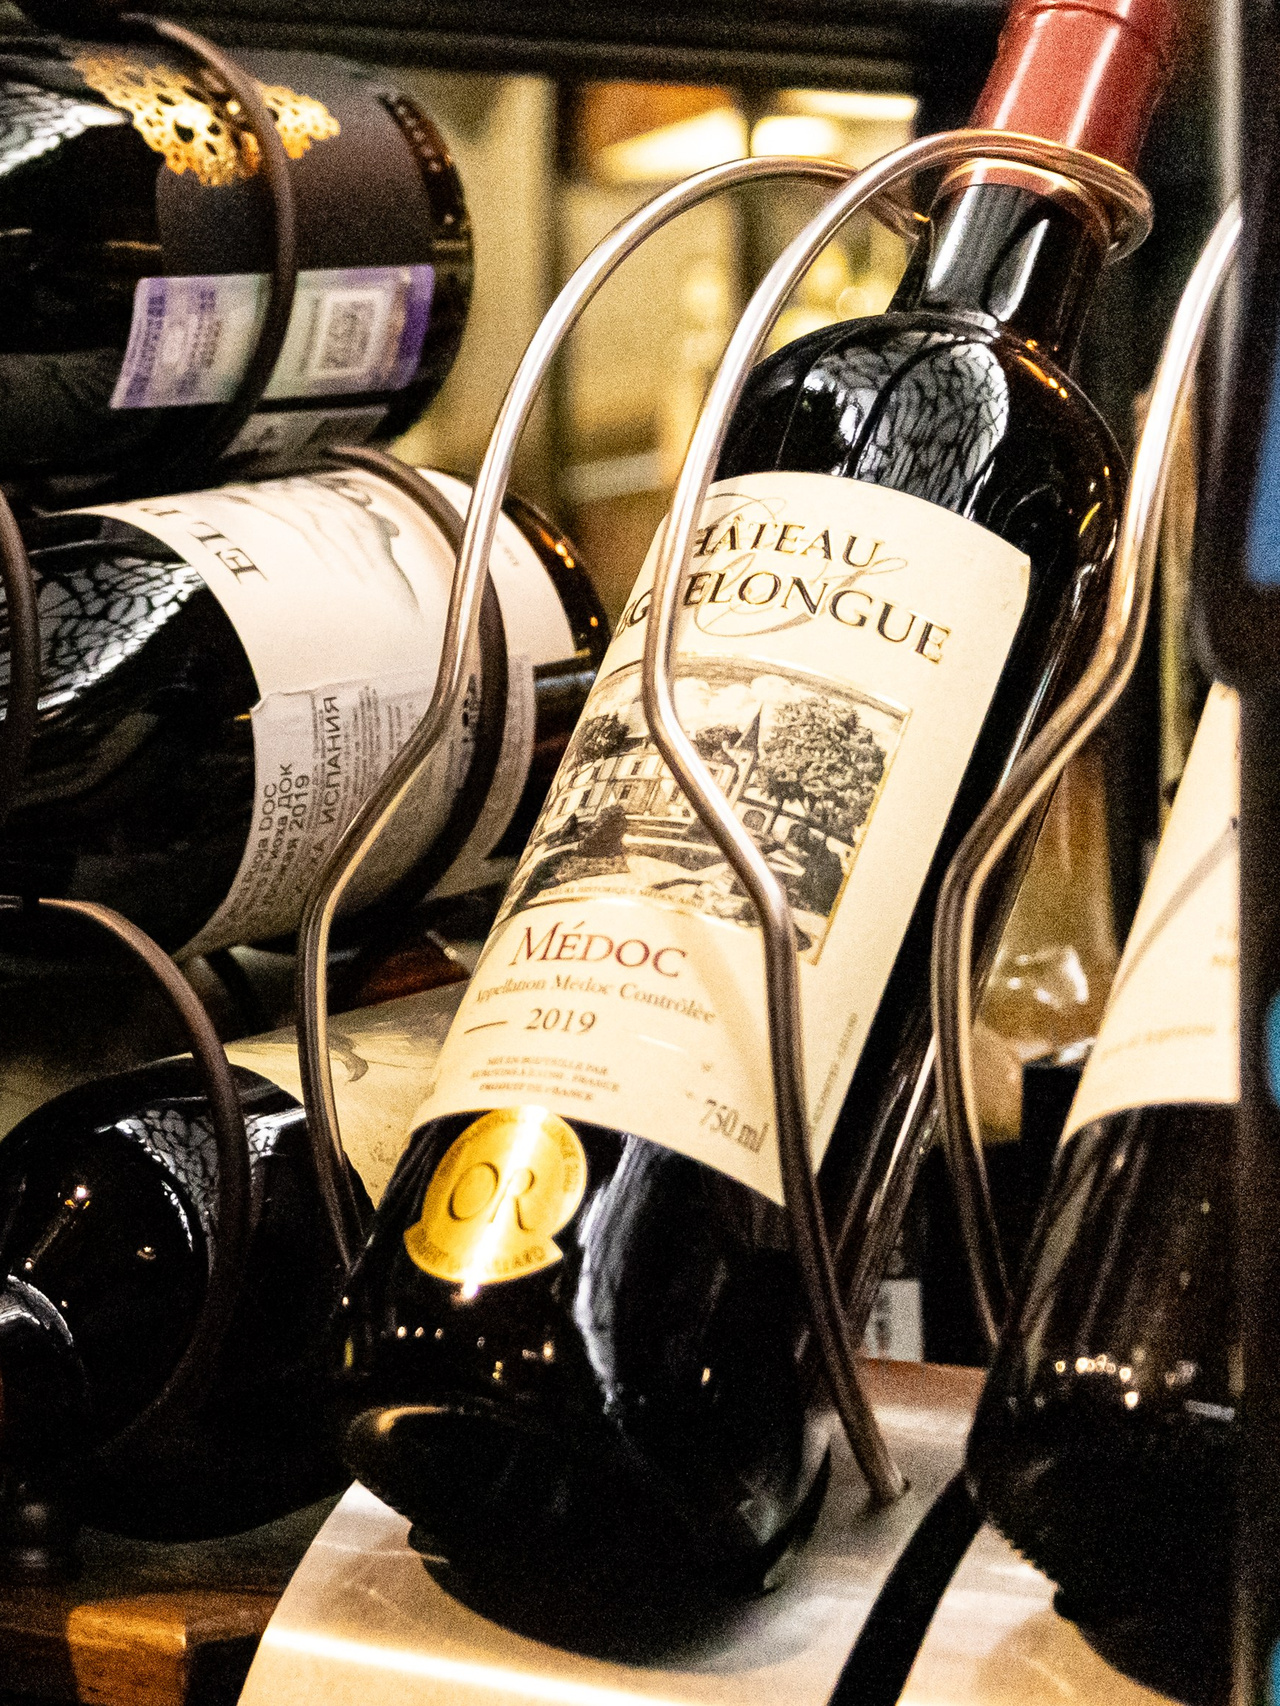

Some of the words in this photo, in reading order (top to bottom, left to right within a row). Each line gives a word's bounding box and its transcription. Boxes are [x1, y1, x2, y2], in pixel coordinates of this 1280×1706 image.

[693, 514, 886, 568] HÂTEAU
[278, 763, 292, 809] ДОК
[320, 696, 341, 825] ИСПАНИЯ
[259, 783, 277, 831] DOC
[289, 775, 310, 831] 2019
[508, 920, 688, 978] MÉDOC
[524, 1007, 598, 1035] 2019
[699, 1098, 740, 1137] 750
